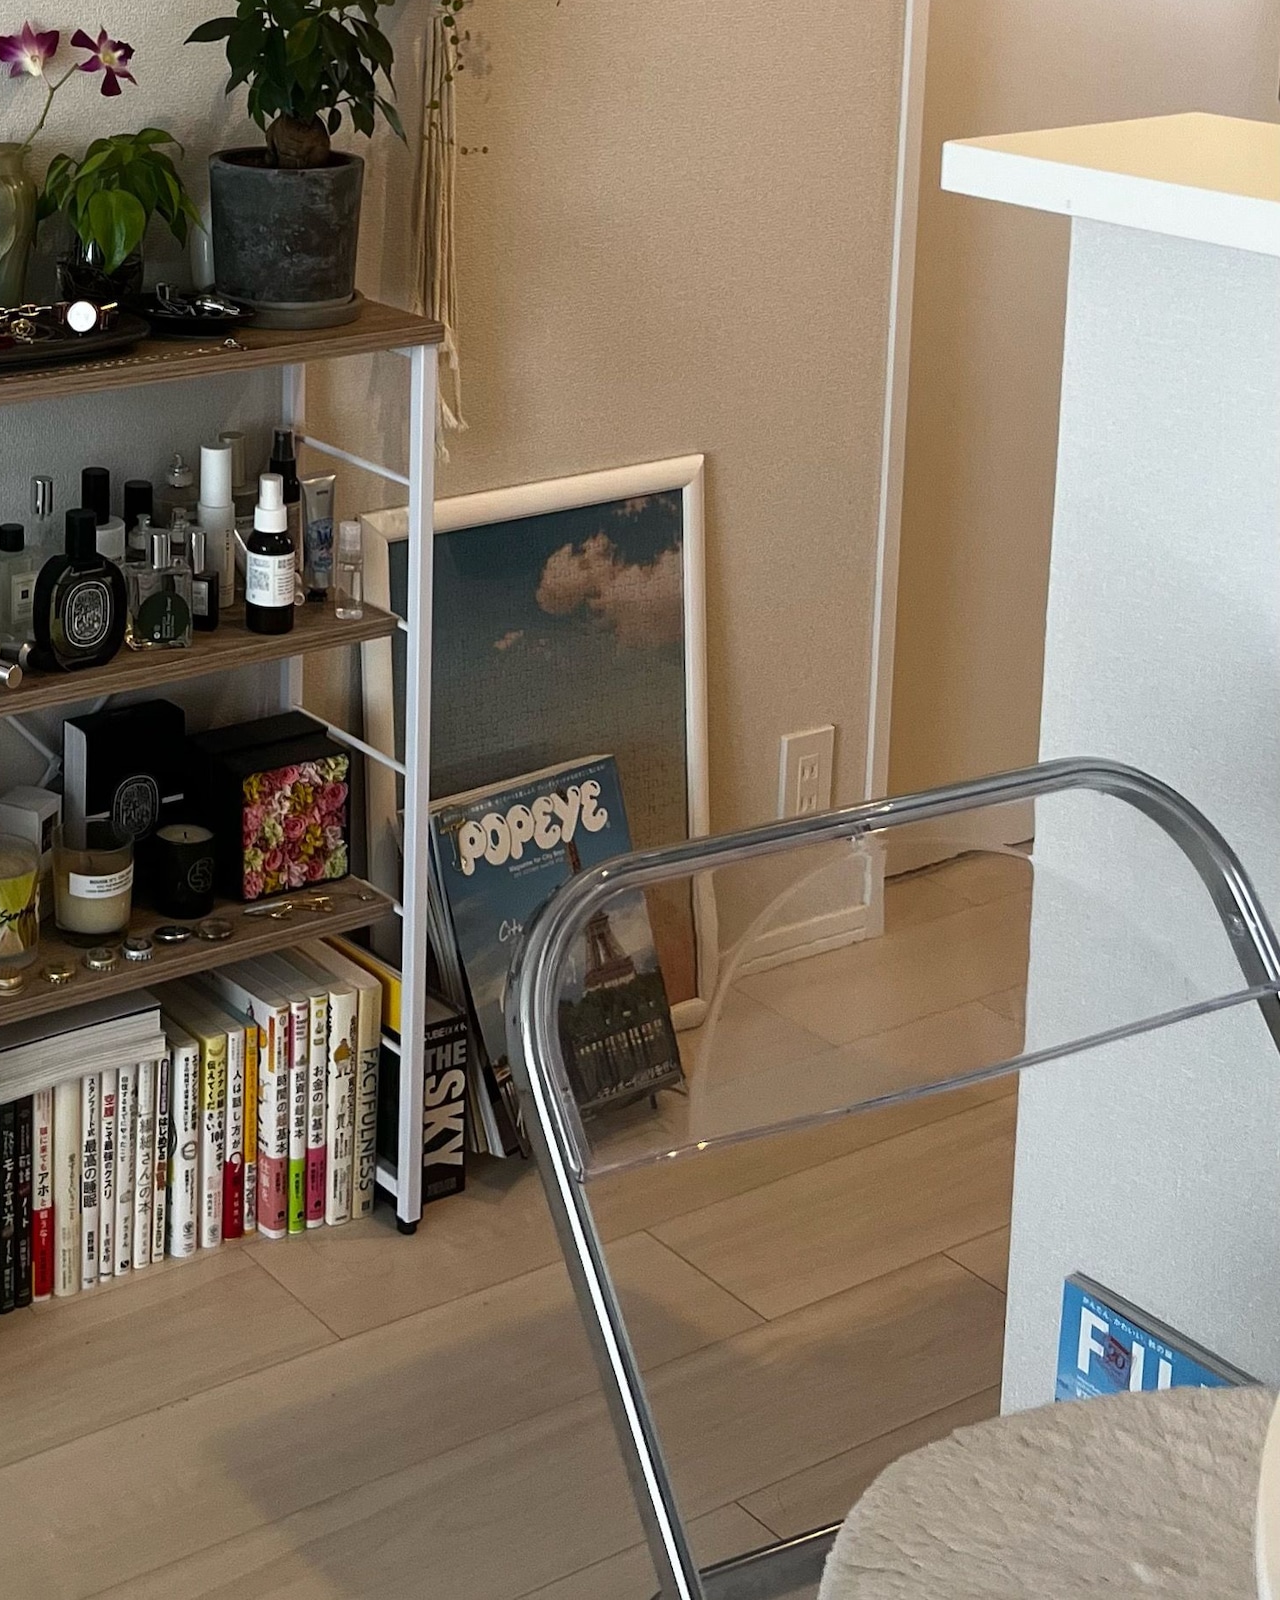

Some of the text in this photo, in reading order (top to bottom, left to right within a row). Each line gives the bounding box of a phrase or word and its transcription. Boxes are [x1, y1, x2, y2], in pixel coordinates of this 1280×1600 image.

[458, 779, 608, 876] POPEYE
[206, 1060, 217, 1132] 伝えてください
[424, 1038, 468, 1074] THE
[275, 1073, 287, 1154] 時間の超基本
[312, 1065, 324, 1144] お金の超基本
[359, 1047, 378, 1191] FACTFULNESS
[423, 1068, 466, 1168] SKY
[83, 1138, 98, 1209] 最高の睡眠
